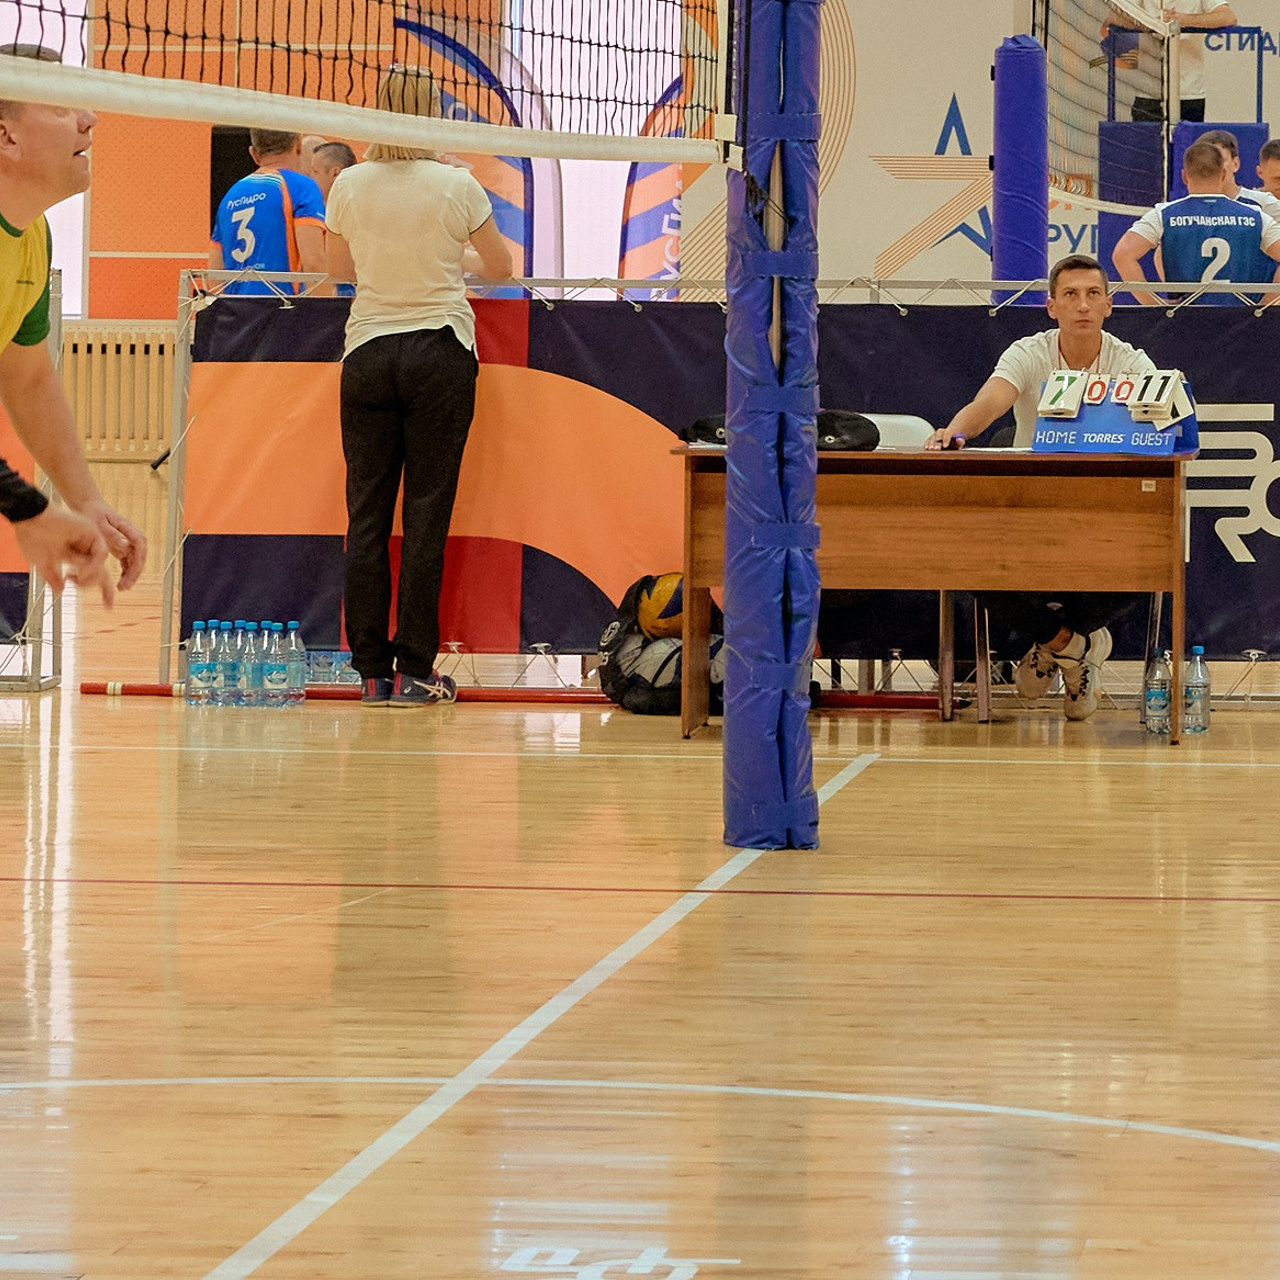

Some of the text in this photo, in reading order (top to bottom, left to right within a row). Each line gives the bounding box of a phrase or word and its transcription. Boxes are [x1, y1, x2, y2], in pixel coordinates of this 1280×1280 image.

[231, 206, 256, 263] 3
[1169, 216, 1256, 227] БОГУЧАНСКАЯ ГЭС
[1201, 237, 1231, 282] 2
[1048, 375, 1077, 405] 7
[1136, 375, 1172, 402] 11
[1035, 430, 1173, 446] HOME TORRES GUEST
